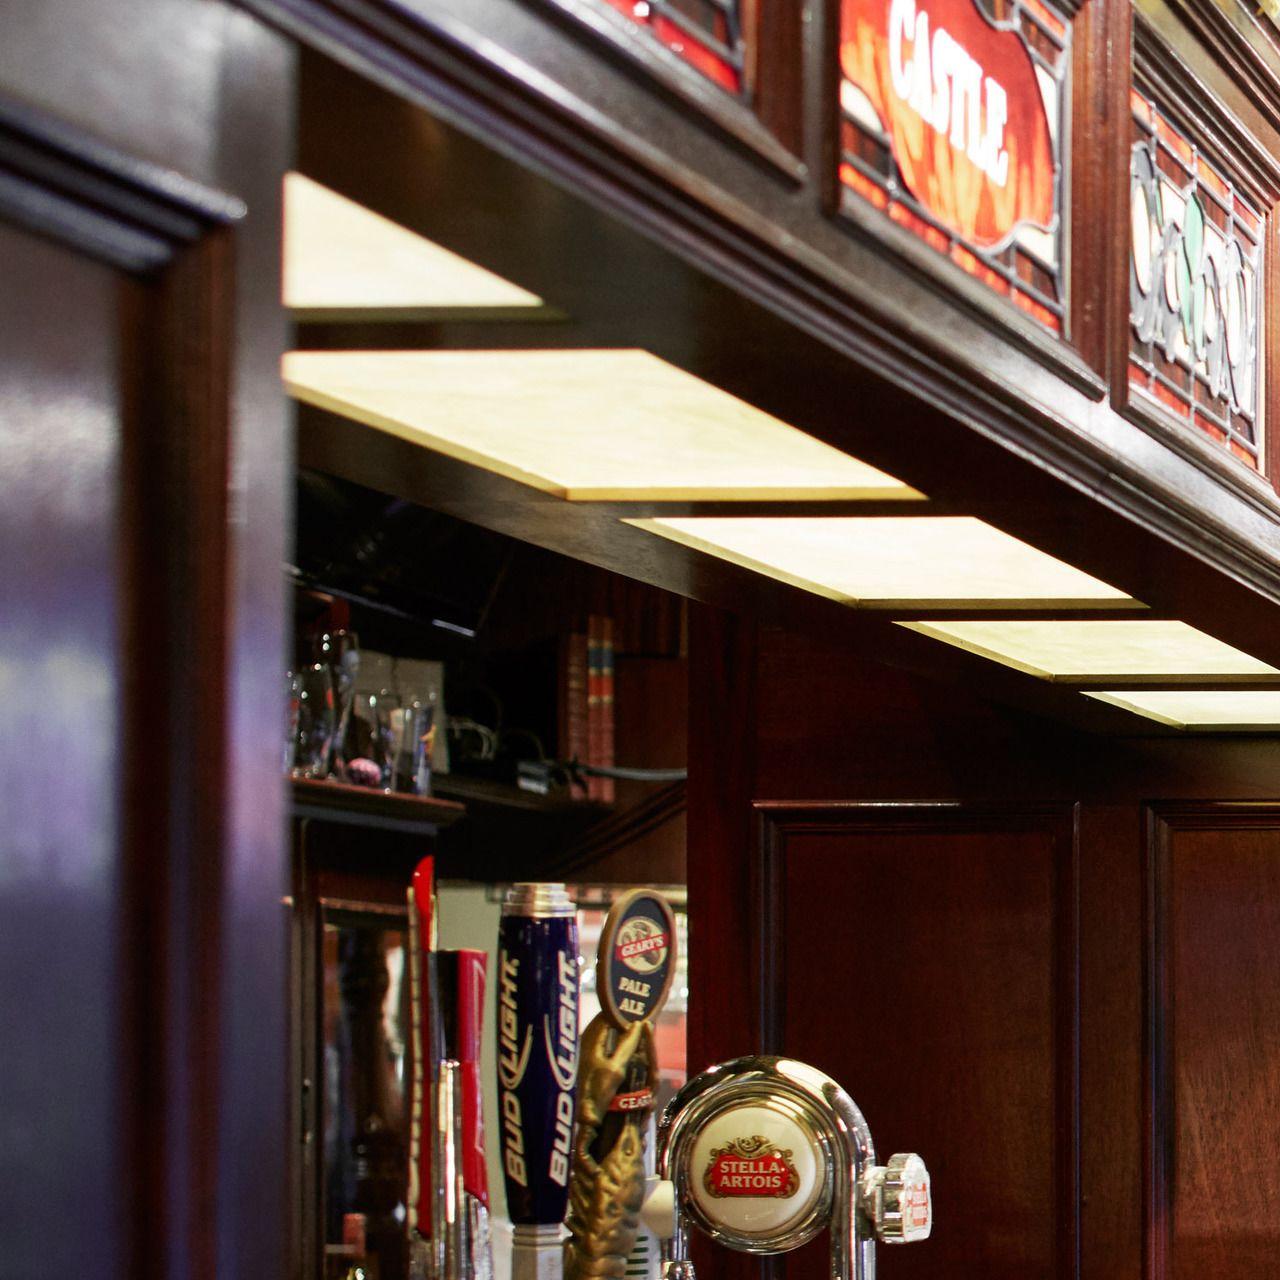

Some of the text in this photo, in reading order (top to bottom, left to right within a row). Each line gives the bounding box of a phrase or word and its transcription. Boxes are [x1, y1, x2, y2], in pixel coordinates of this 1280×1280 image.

[621, 936, 664, 957] GEARY'S
[618, 976, 651, 998] PALE
[619, 998, 646, 1016] ALE
[500, 950, 530, 1187] BUD LIGHT
[546, 950, 578, 1187] BUD LIGHT
[720, 1161, 780, 1174] STELLA
[720, 1175, 782, 1188] ARTOIS
